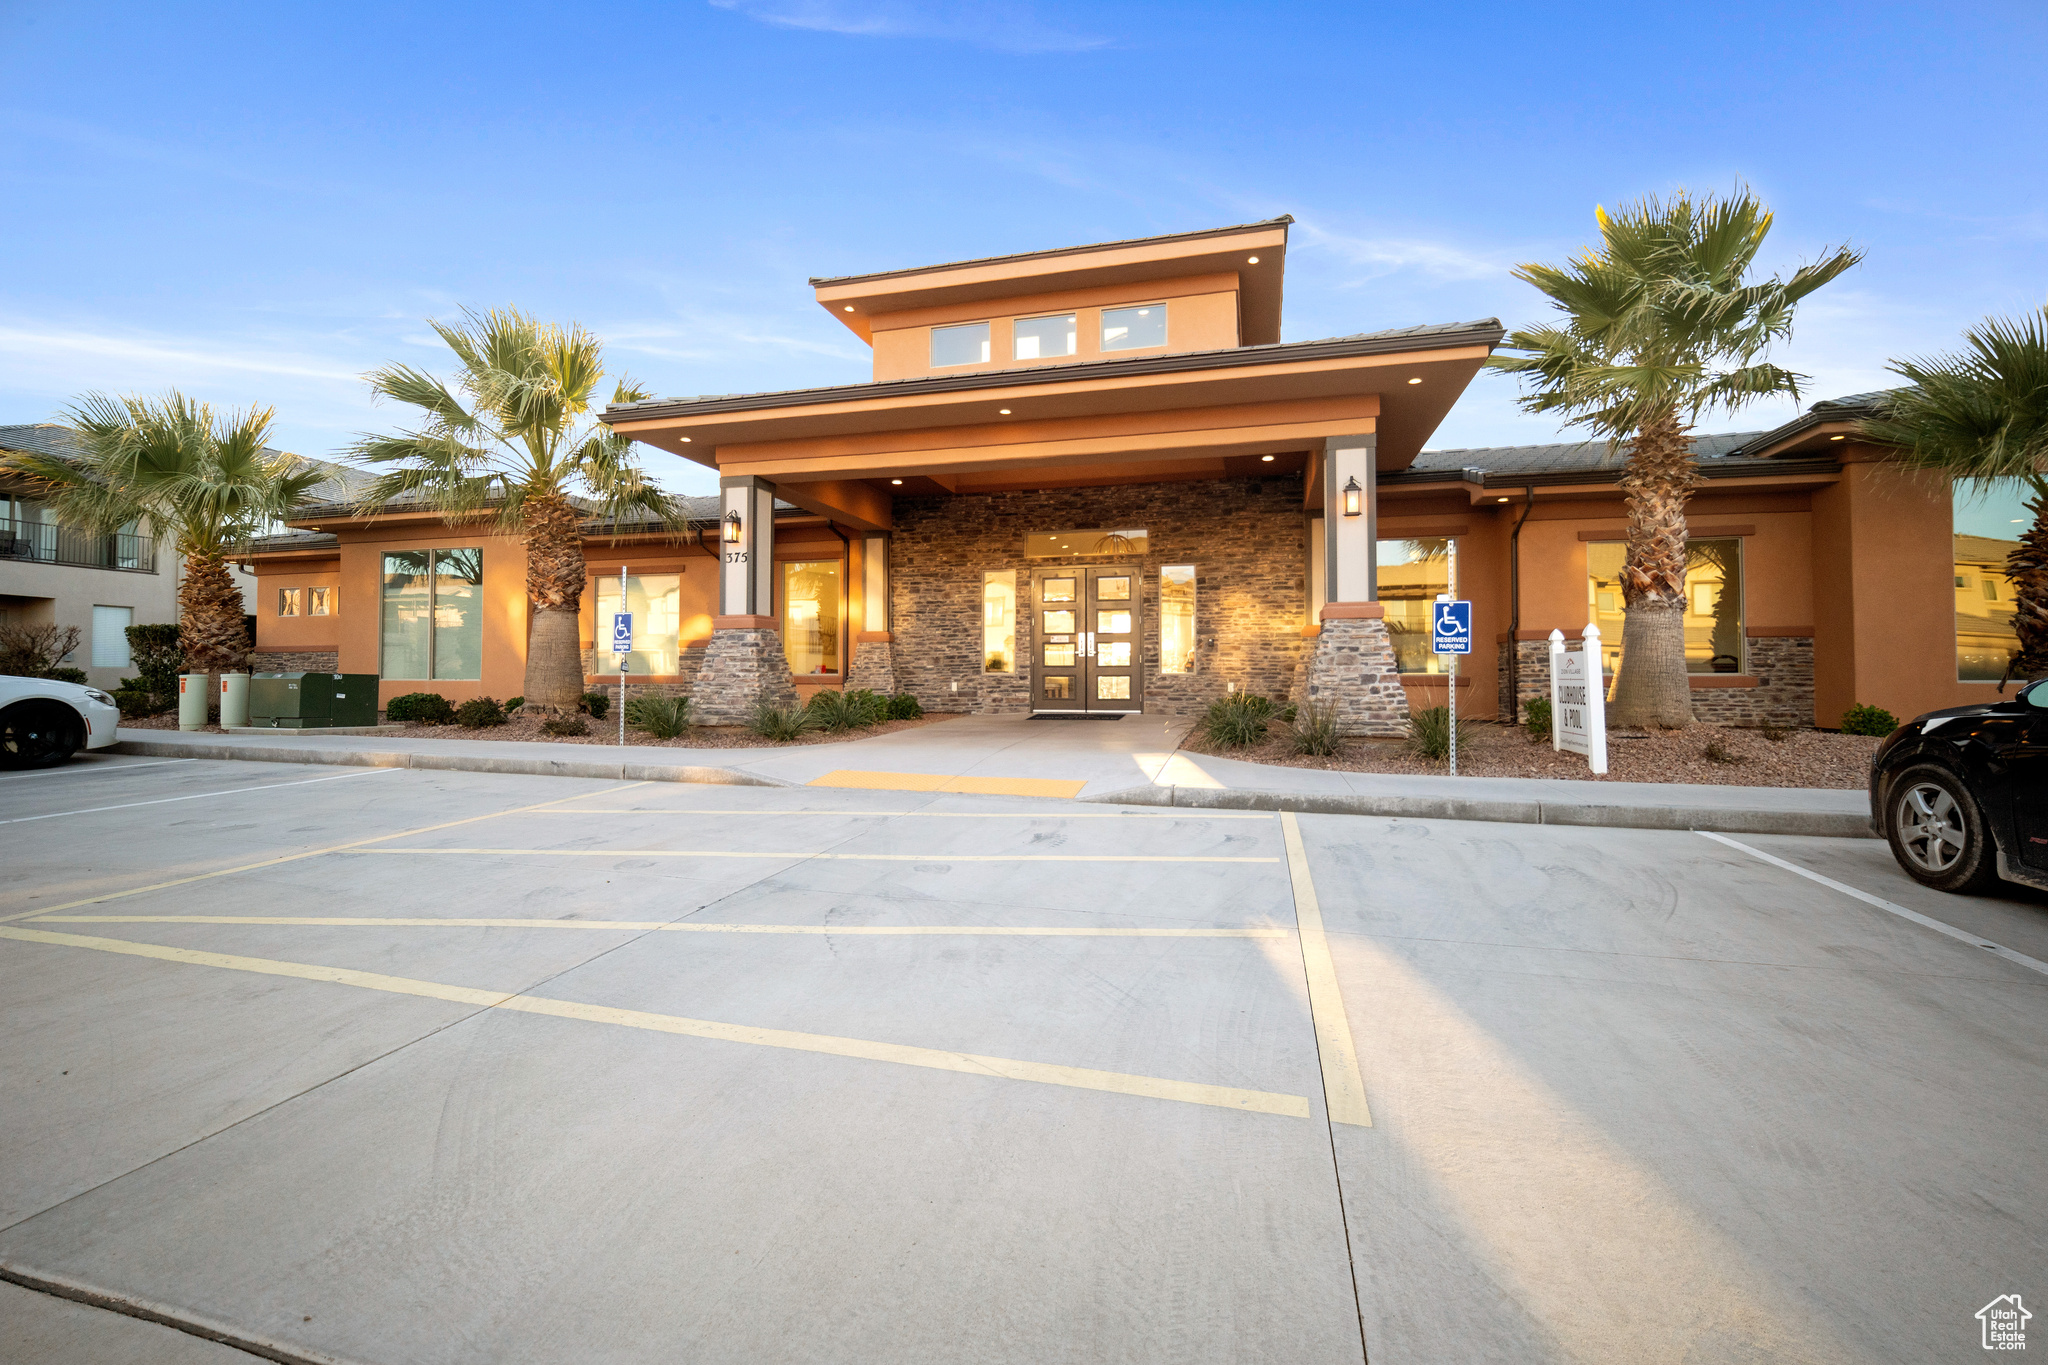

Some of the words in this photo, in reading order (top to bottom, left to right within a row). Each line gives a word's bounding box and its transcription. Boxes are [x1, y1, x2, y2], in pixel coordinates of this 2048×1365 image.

[726, 552, 748, 563] 375
[1559, 685, 1586, 706] CLUBHOUSE
[1564, 708, 1568, 727] &
[1569, 708, 1583, 729] POOL
